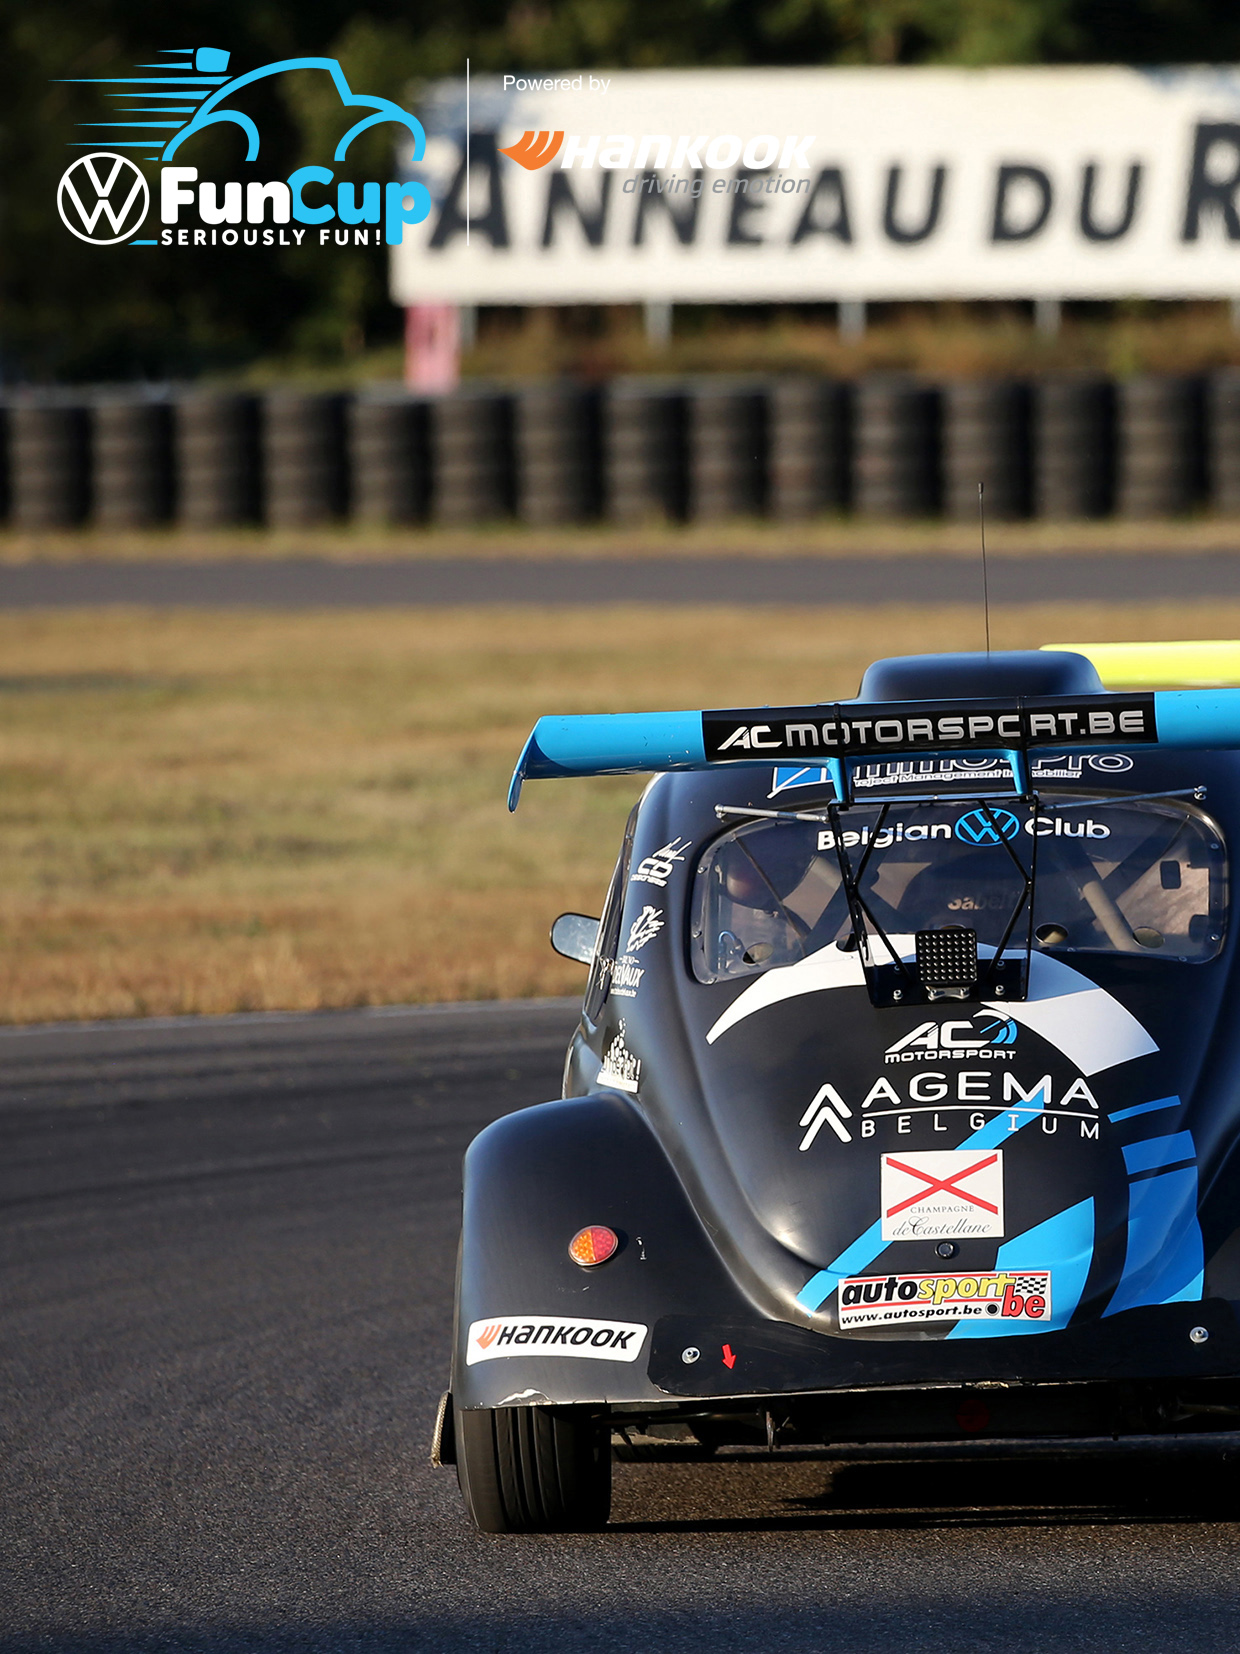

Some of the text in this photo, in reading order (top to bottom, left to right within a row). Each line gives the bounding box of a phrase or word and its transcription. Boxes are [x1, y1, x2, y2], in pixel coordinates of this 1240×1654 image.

[427, 130, 951, 249] ANNEAU
[989, 161, 1147, 248] DU
[716, 710, 1146, 752] AC MOTORSPORT.BE
[854, 775, 899, 788] roject
[898, 770, 1002, 784] Management
[817, 822, 952, 851] Belgian
[1024, 816, 1112, 840] Club
[884, 1050, 1017, 1064] MOTORSPORT
[860, 1070, 1099, 1110] AGEMA
[861, 1112, 1099, 1140] BELGIUM
[910, 1204, 975, 1214] CHAMPAGNE
[841, 1273, 1016, 1306] autosport
[841, 1304, 983, 1326] www.autosport.be
